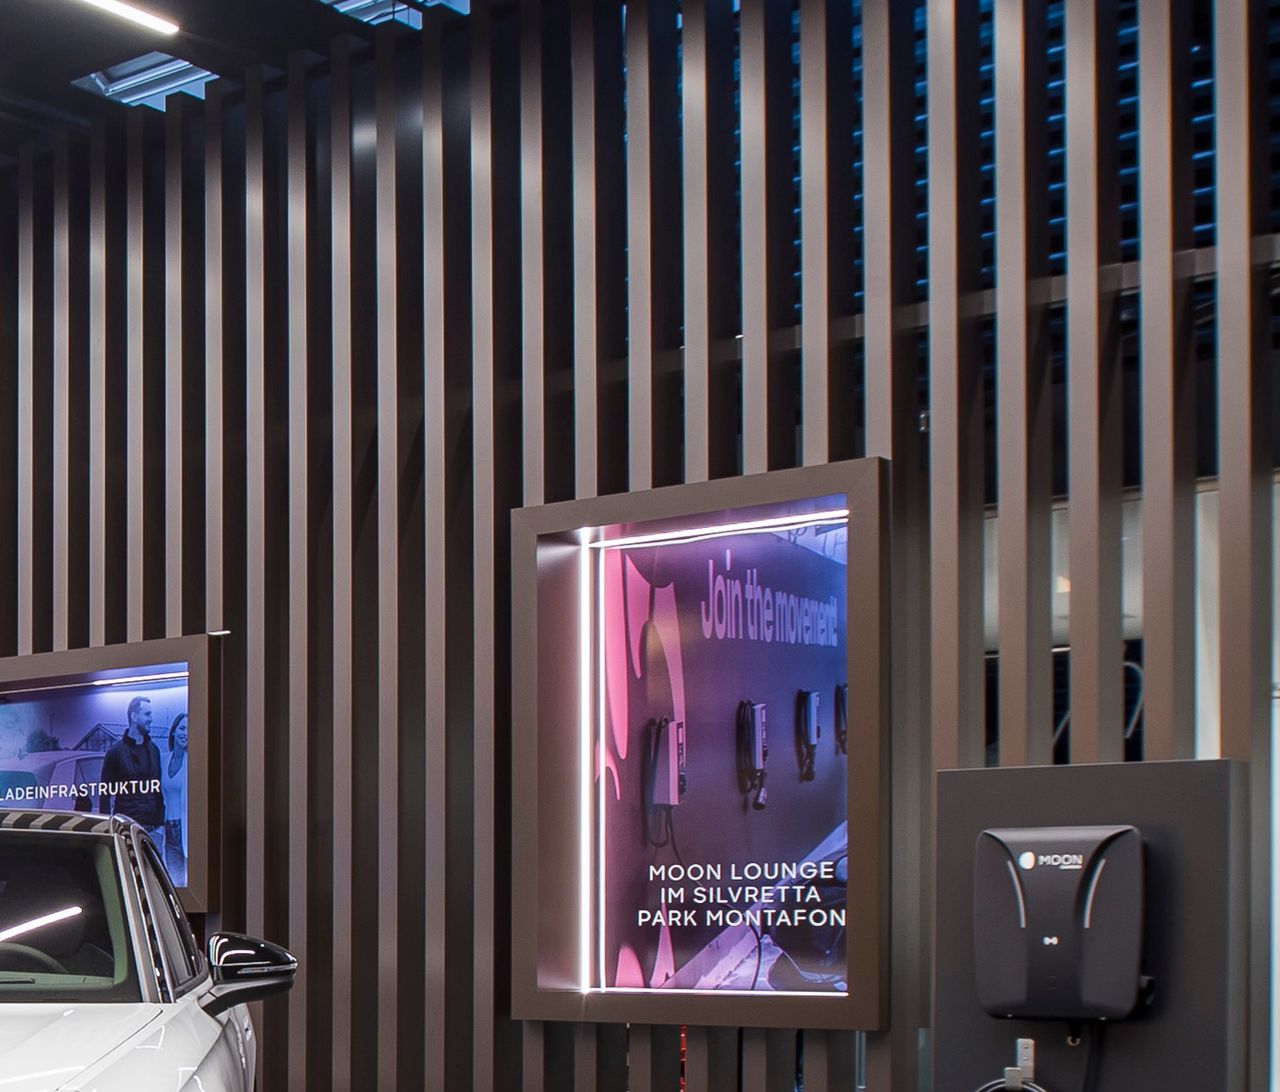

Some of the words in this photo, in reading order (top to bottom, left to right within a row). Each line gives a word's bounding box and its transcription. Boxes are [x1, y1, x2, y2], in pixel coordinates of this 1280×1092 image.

[701, 549, 743, 640] Join
[745, 568, 774, 643] the
[1038, 854, 1084, 865] MOON
[649, 864, 722, 881] MOON
[731, 861, 834, 880] LOUNGE
[661, 887, 684, 903] IM
[693, 885, 822, 904] SILVRETTA
[638, 910, 697, 926] PARK
[706, 908, 846, 926] MONTAFON
